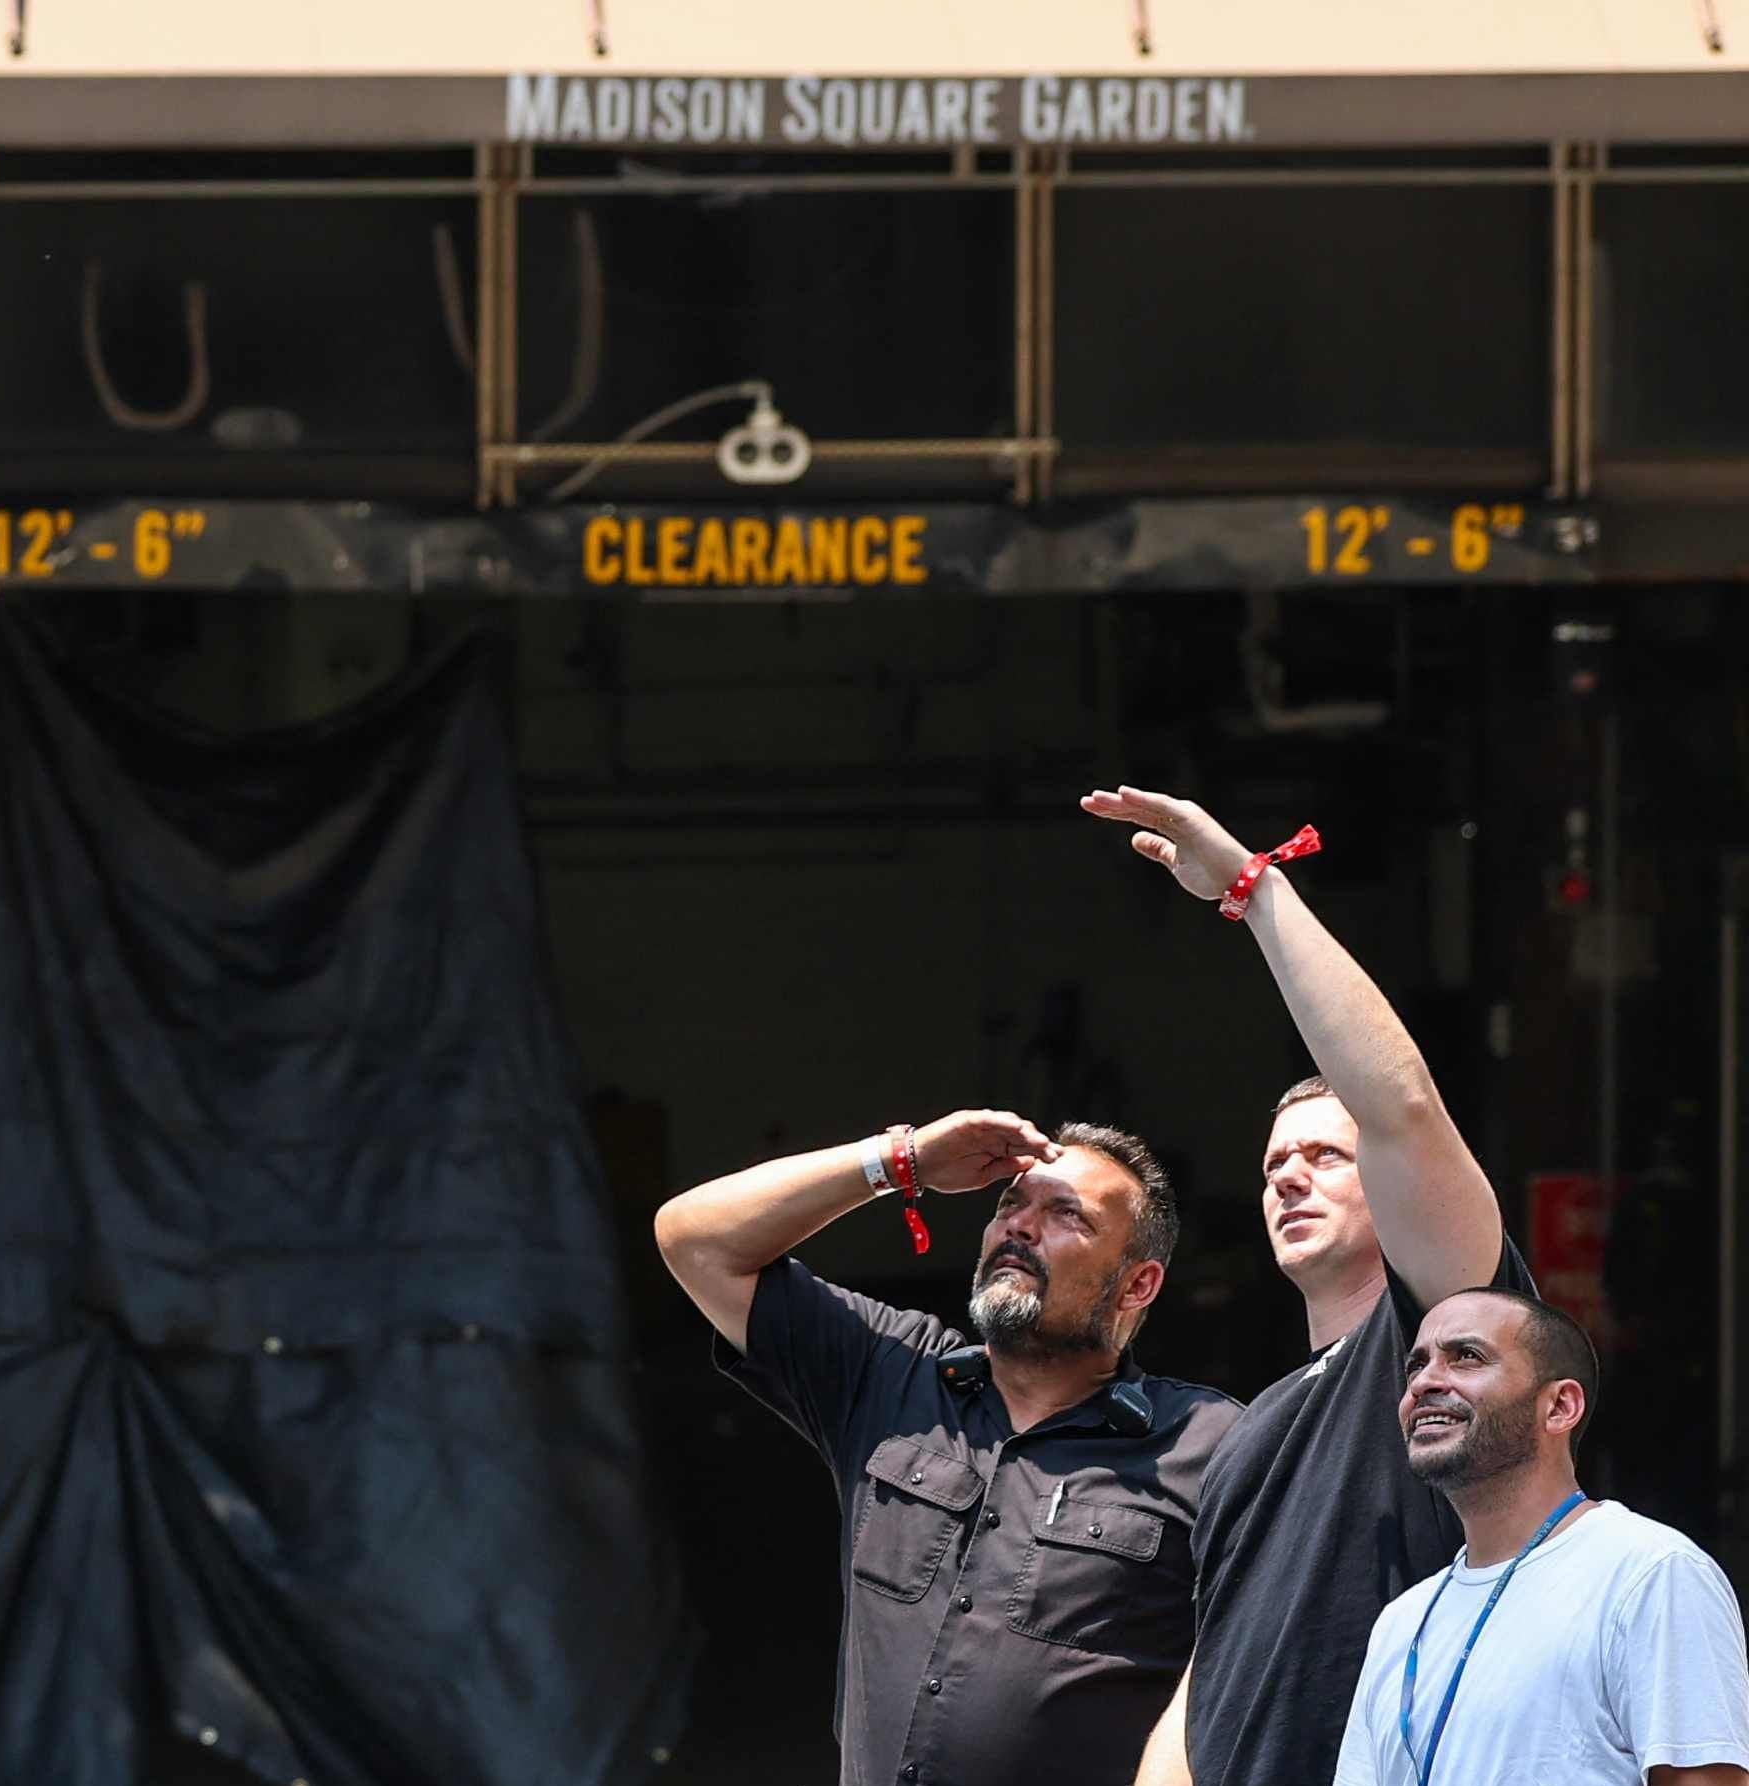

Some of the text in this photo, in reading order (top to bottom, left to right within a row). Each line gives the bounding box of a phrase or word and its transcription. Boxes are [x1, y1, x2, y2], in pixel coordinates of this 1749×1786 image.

[505, 74, 764, 145] MADISON
[782, 74, 999, 147] SQUARE
[583, 515, 928, 585] CLEARANCE
